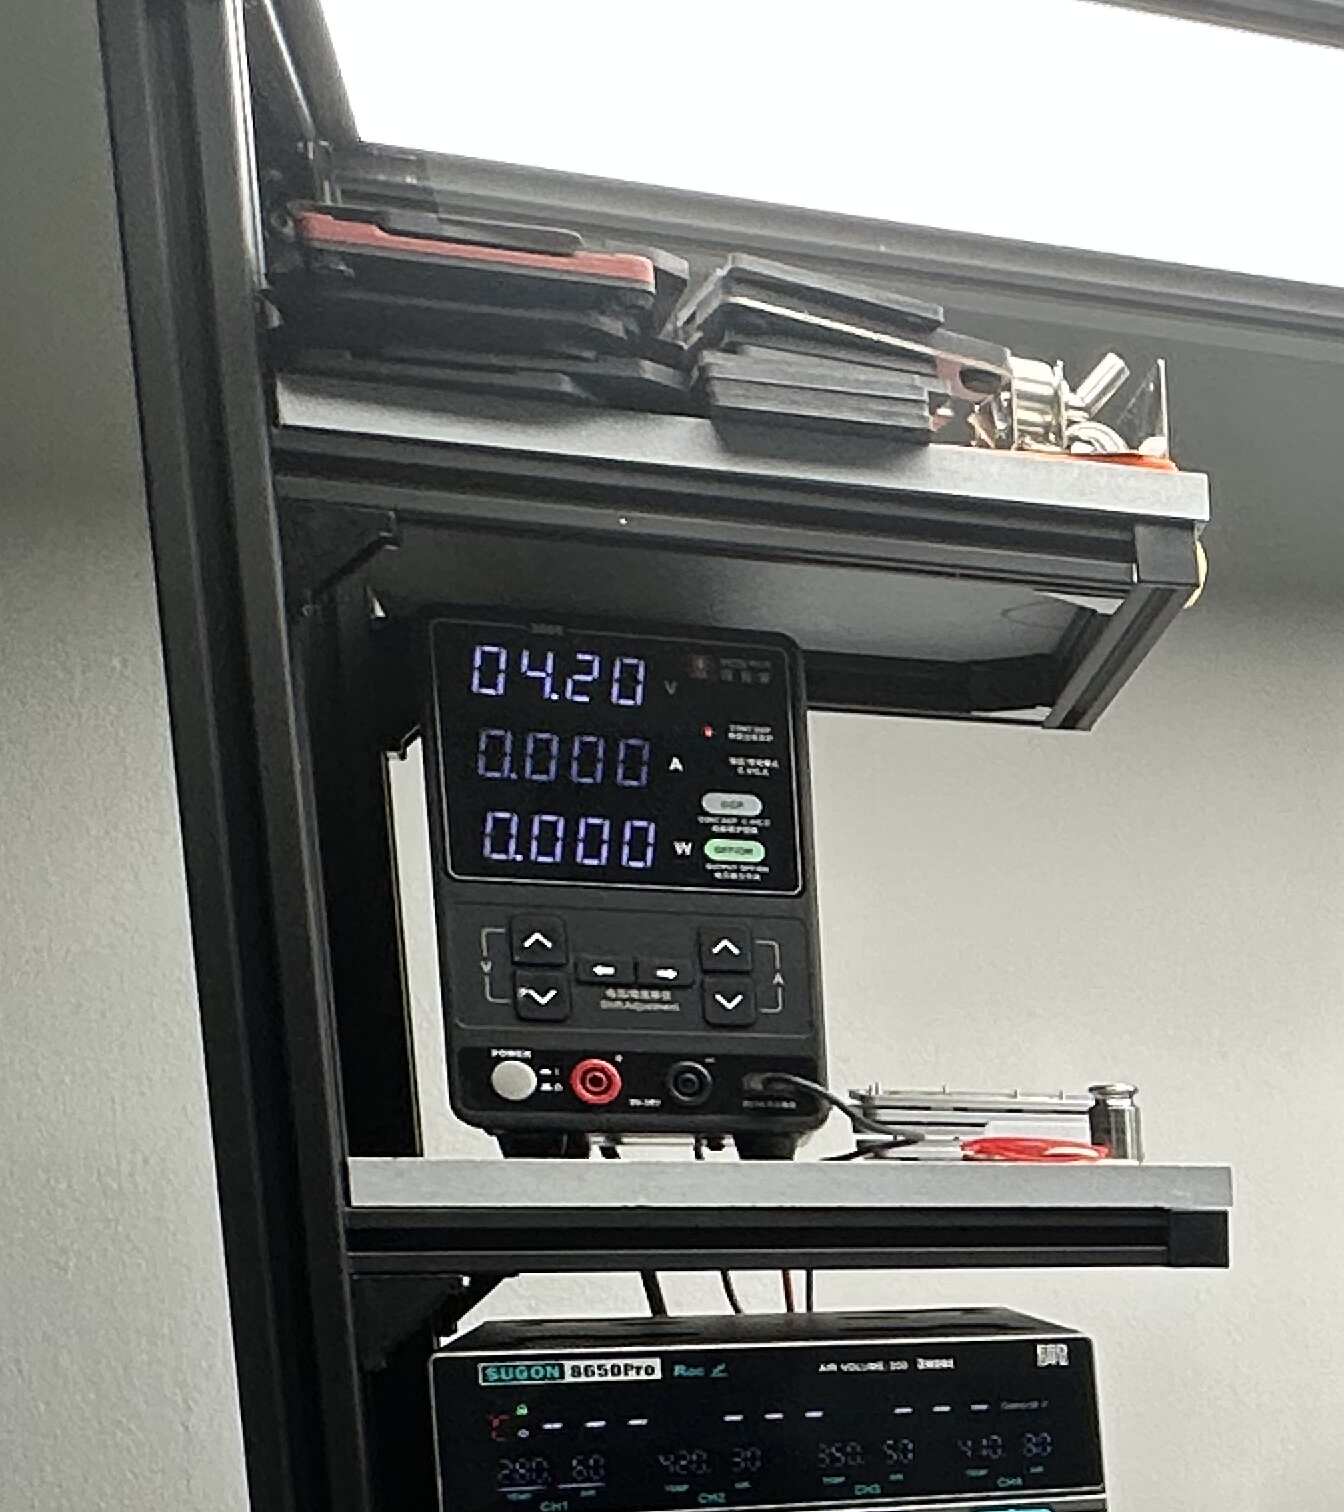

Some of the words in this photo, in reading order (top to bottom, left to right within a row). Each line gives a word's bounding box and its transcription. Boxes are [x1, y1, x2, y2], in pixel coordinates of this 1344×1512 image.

[471, 644, 646, 706] 04.20
[477, 728, 651, 787] 0.000
[668, 756, 684, 772] A
[483, 811, 656, 868] 0.000
[673, 841, 693, 856] W
[485, 1365, 561, 1381] SUGON
